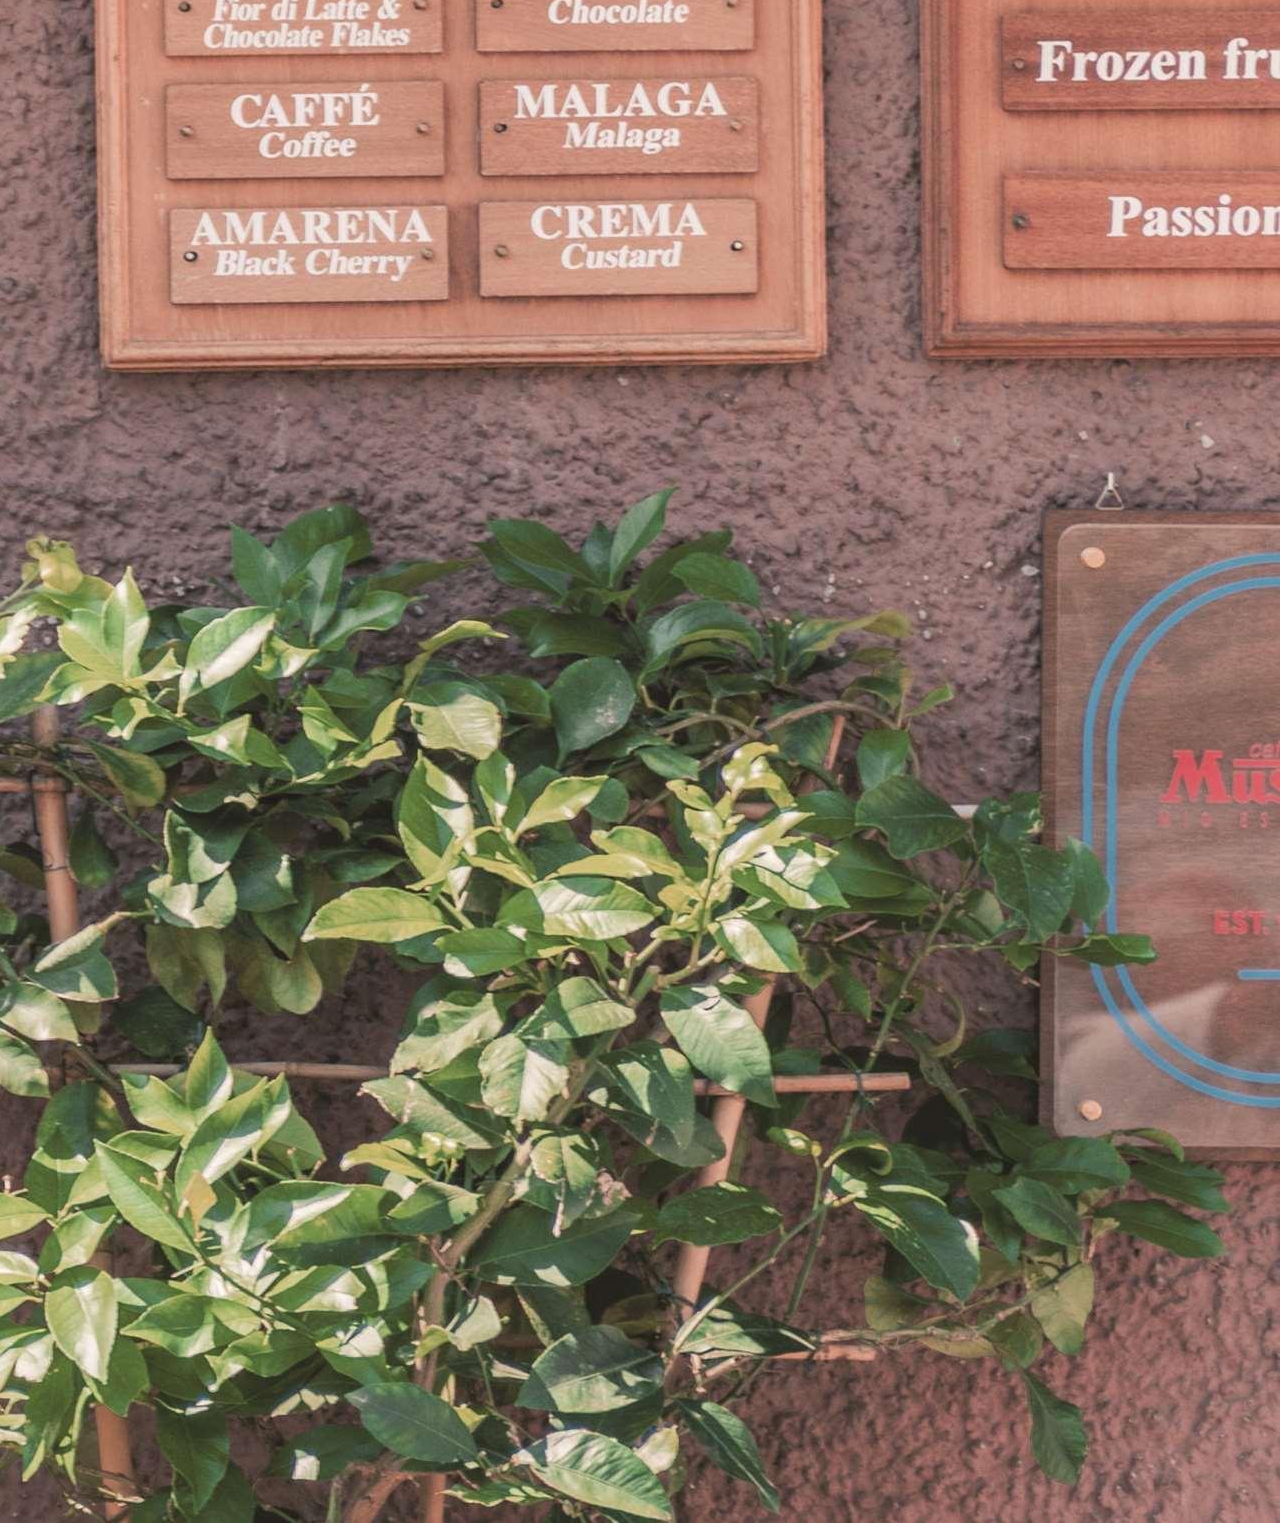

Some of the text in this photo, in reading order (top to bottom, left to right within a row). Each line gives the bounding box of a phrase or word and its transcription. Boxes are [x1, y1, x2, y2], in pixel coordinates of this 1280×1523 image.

[203, 22, 410, 49] Chocolate Flakes
[1035, 39, 1207, 82] Frozen
[231, 83, 380, 128] CAFFÉ
[513, 83, 725, 118] MALAGA
[259, 132, 356, 159] Coffee
[563, 122, 680, 154] Malaga
[191, 209, 432, 246] AMARENA
[531, 203, 705, 239] CREMA
[215, 248, 412, 281] Black Cherry
[561, 242, 681, 270] Custard
[1213, 910, 1271, 936] EST.
